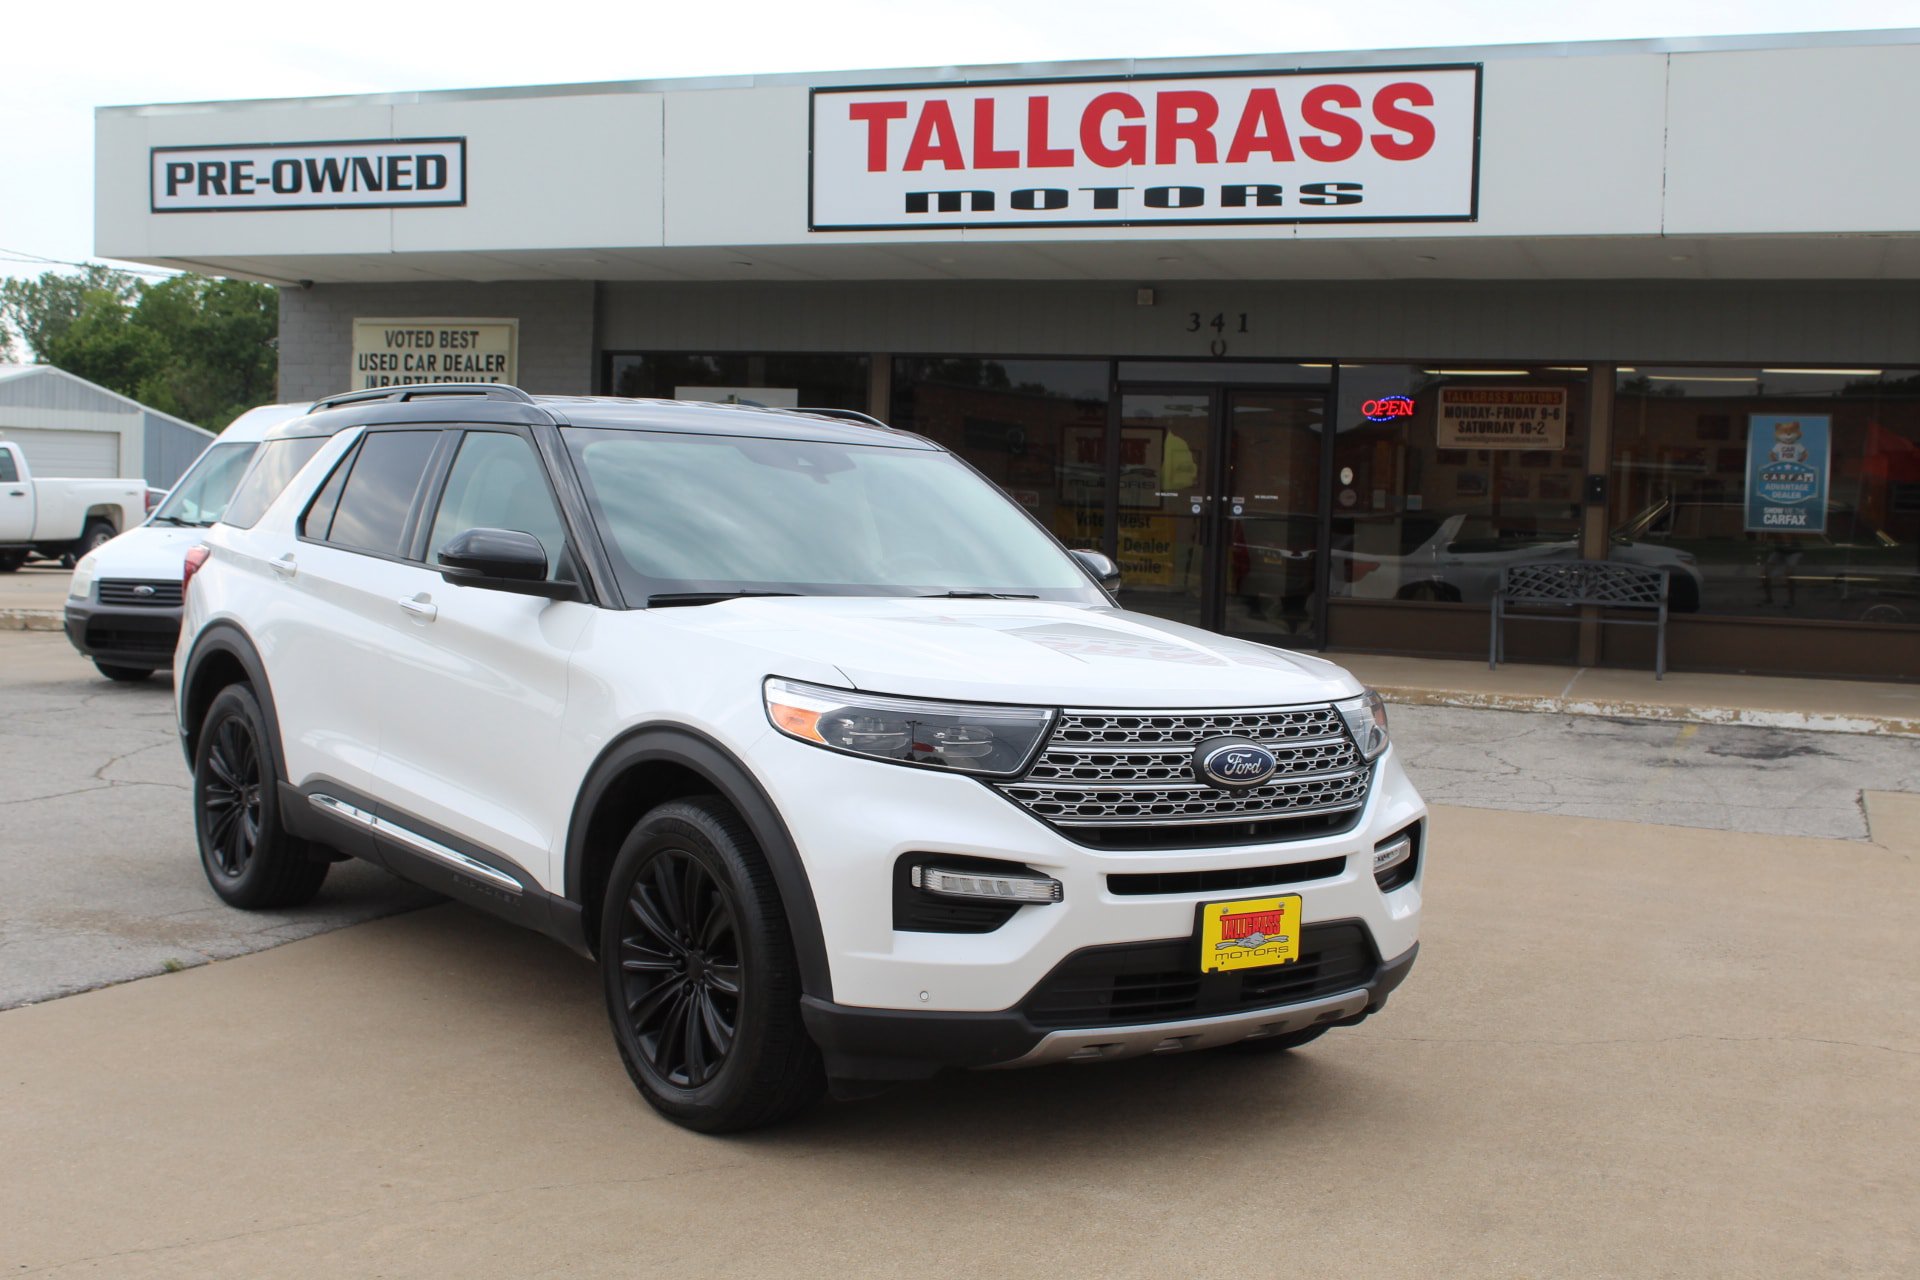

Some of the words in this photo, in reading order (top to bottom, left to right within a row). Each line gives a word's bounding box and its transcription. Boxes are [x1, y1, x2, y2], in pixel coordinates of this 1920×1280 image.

[849, 82, 1436, 172] TALLGRASS
[166, 154, 447, 196] PRE-OWNED
[905, 182, 1363, 213] MOTORS
[385, 330, 434, 348] VOTED
[439, 331, 479, 349] BEST
[359, 353, 397, 371] USED
[404, 354, 437, 372] CAR
[443, 354, 506, 373] DEALER
[1446, 391, 1509, 401] TALLGRASS
[1362, 400, 1414, 416] OPEN
[1444, 406, 1537, 419] MONDAY-FRIDAY
[1541, 407, 1560, 420] 9-6
[1458, 421, 1515, 434] SATURDAY
[1520, 421, 1545, 435] 10-2
[1763, 514, 1807, 526] CARFAX
[1124, 537, 1170, 553] Dealer
[1224, 752, 1263, 775] Ford
[1219, 909, 1284, 940] TALLGRASS
[1215, 946, 1289, 960] MOTORS
